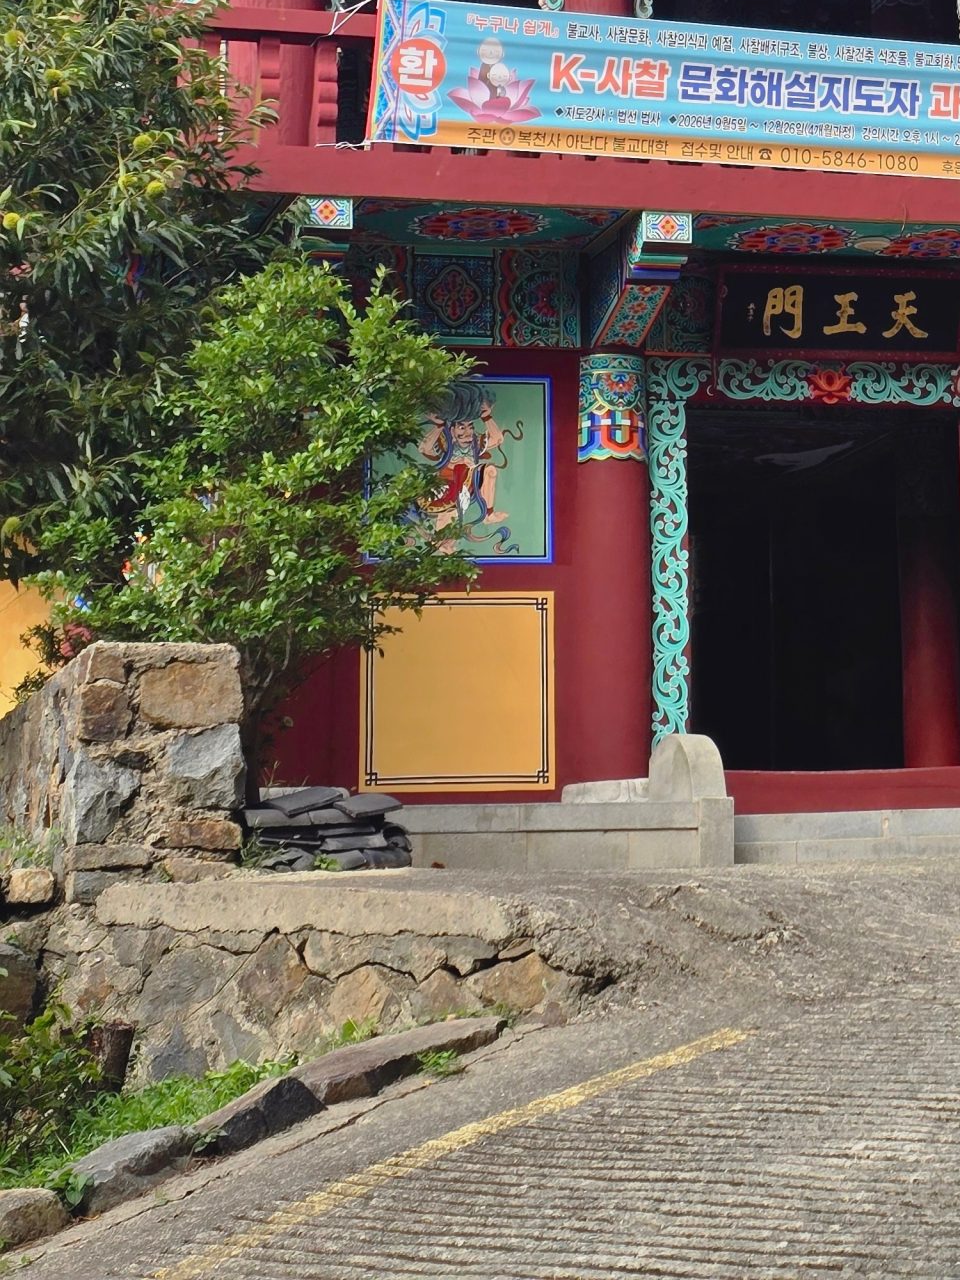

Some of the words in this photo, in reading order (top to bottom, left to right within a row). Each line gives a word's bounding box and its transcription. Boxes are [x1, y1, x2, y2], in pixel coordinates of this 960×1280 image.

[567, 23, 602, 42] 불교사,
[606, 26, 652, 47] 사찰문화,
[656, 31, 708, 51] 사찰의식과
[711, 34, 736, 54] 예절,
[739, 37, 803, 59] 사찰배치구조,
[807, 43, 831, 61] 불상,
[834, 46, 875, 63] 사찰건축
[398, 46, 438, 88] 환
[551, 53, 671, 99] K-사찰
[679, 63, 920, 117] 문화해설지도자
[617, 110, 638, 124] 법선
[641, 111, 661, 126] 법사
[678, 114, 713, 131] 2026년
[862, 127, 900, 143] 강의시간
[902, 130, 922, 145] 오후
[924, 131, 940, 146] 1시
[466, 127, 497, 145] 주관
[517, 130, 563, 149] 복천사
[565, 134, 608, 152] 아난다
[612, 137, 669, 155] 불교대학
[680, 141, 723, 159] 접수및
[726, 144, 754, 161] 안내
[780, 146, 920, 172] 010-5846-1080
